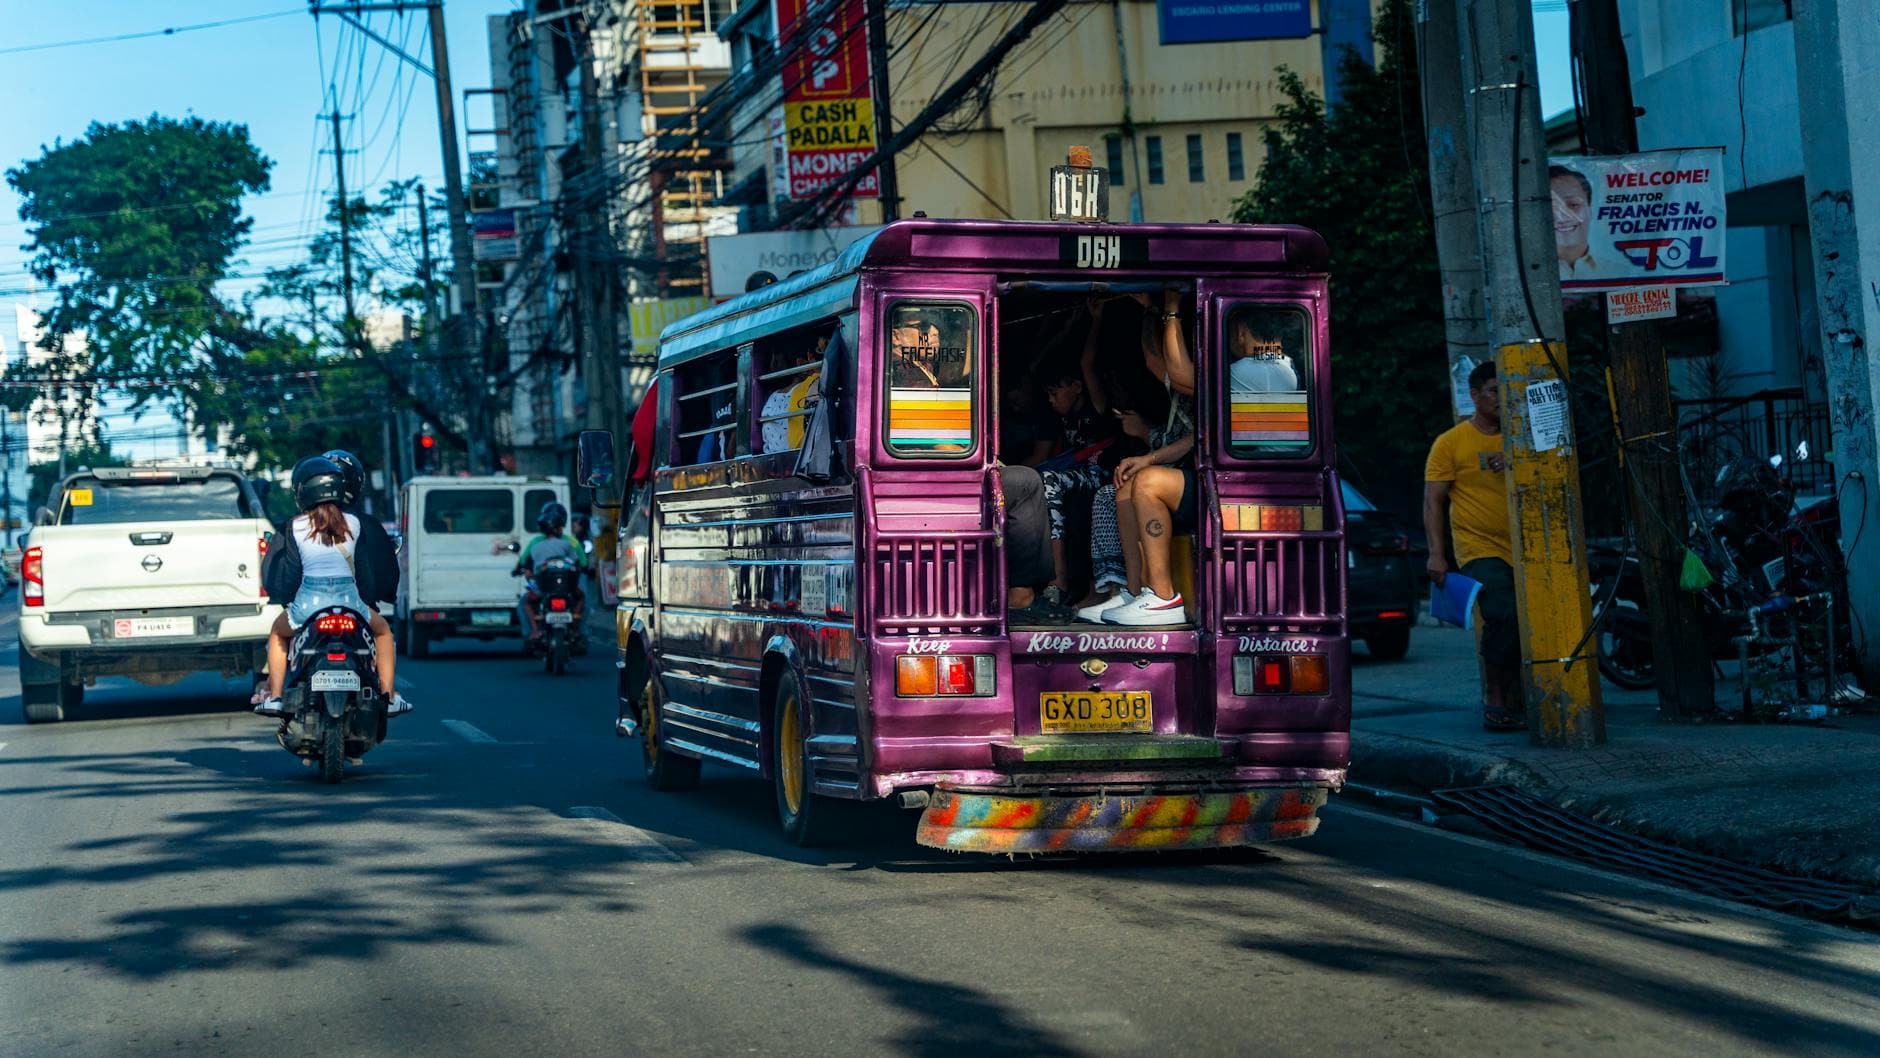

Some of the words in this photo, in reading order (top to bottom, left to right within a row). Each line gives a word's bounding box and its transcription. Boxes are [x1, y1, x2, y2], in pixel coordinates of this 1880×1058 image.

[1217, 4, 1260, 15] LENDING
[1263, 2, 1301, 13] CENTER
[800, 102, 857, 125] CASH
[790, 125, 870, 147] PADALA
[1606, 169, 1710, 188] WELCOME!
[1605, 192, 1664, 204] SENATOR
[1597, 202, 1680, 220] FRANCIS
[1684, 201, 1704, 215] N.
[1608, 216, 1718, 235] TOLENTINO
[1614, 236, 1719, 271] TOL
[906, 637, 953, 654] Keep
[1026, 632, 1075, 654] Keep
[1044, 697, 1092, 720] GXD
[1099, 696, 1148, 720] 308
